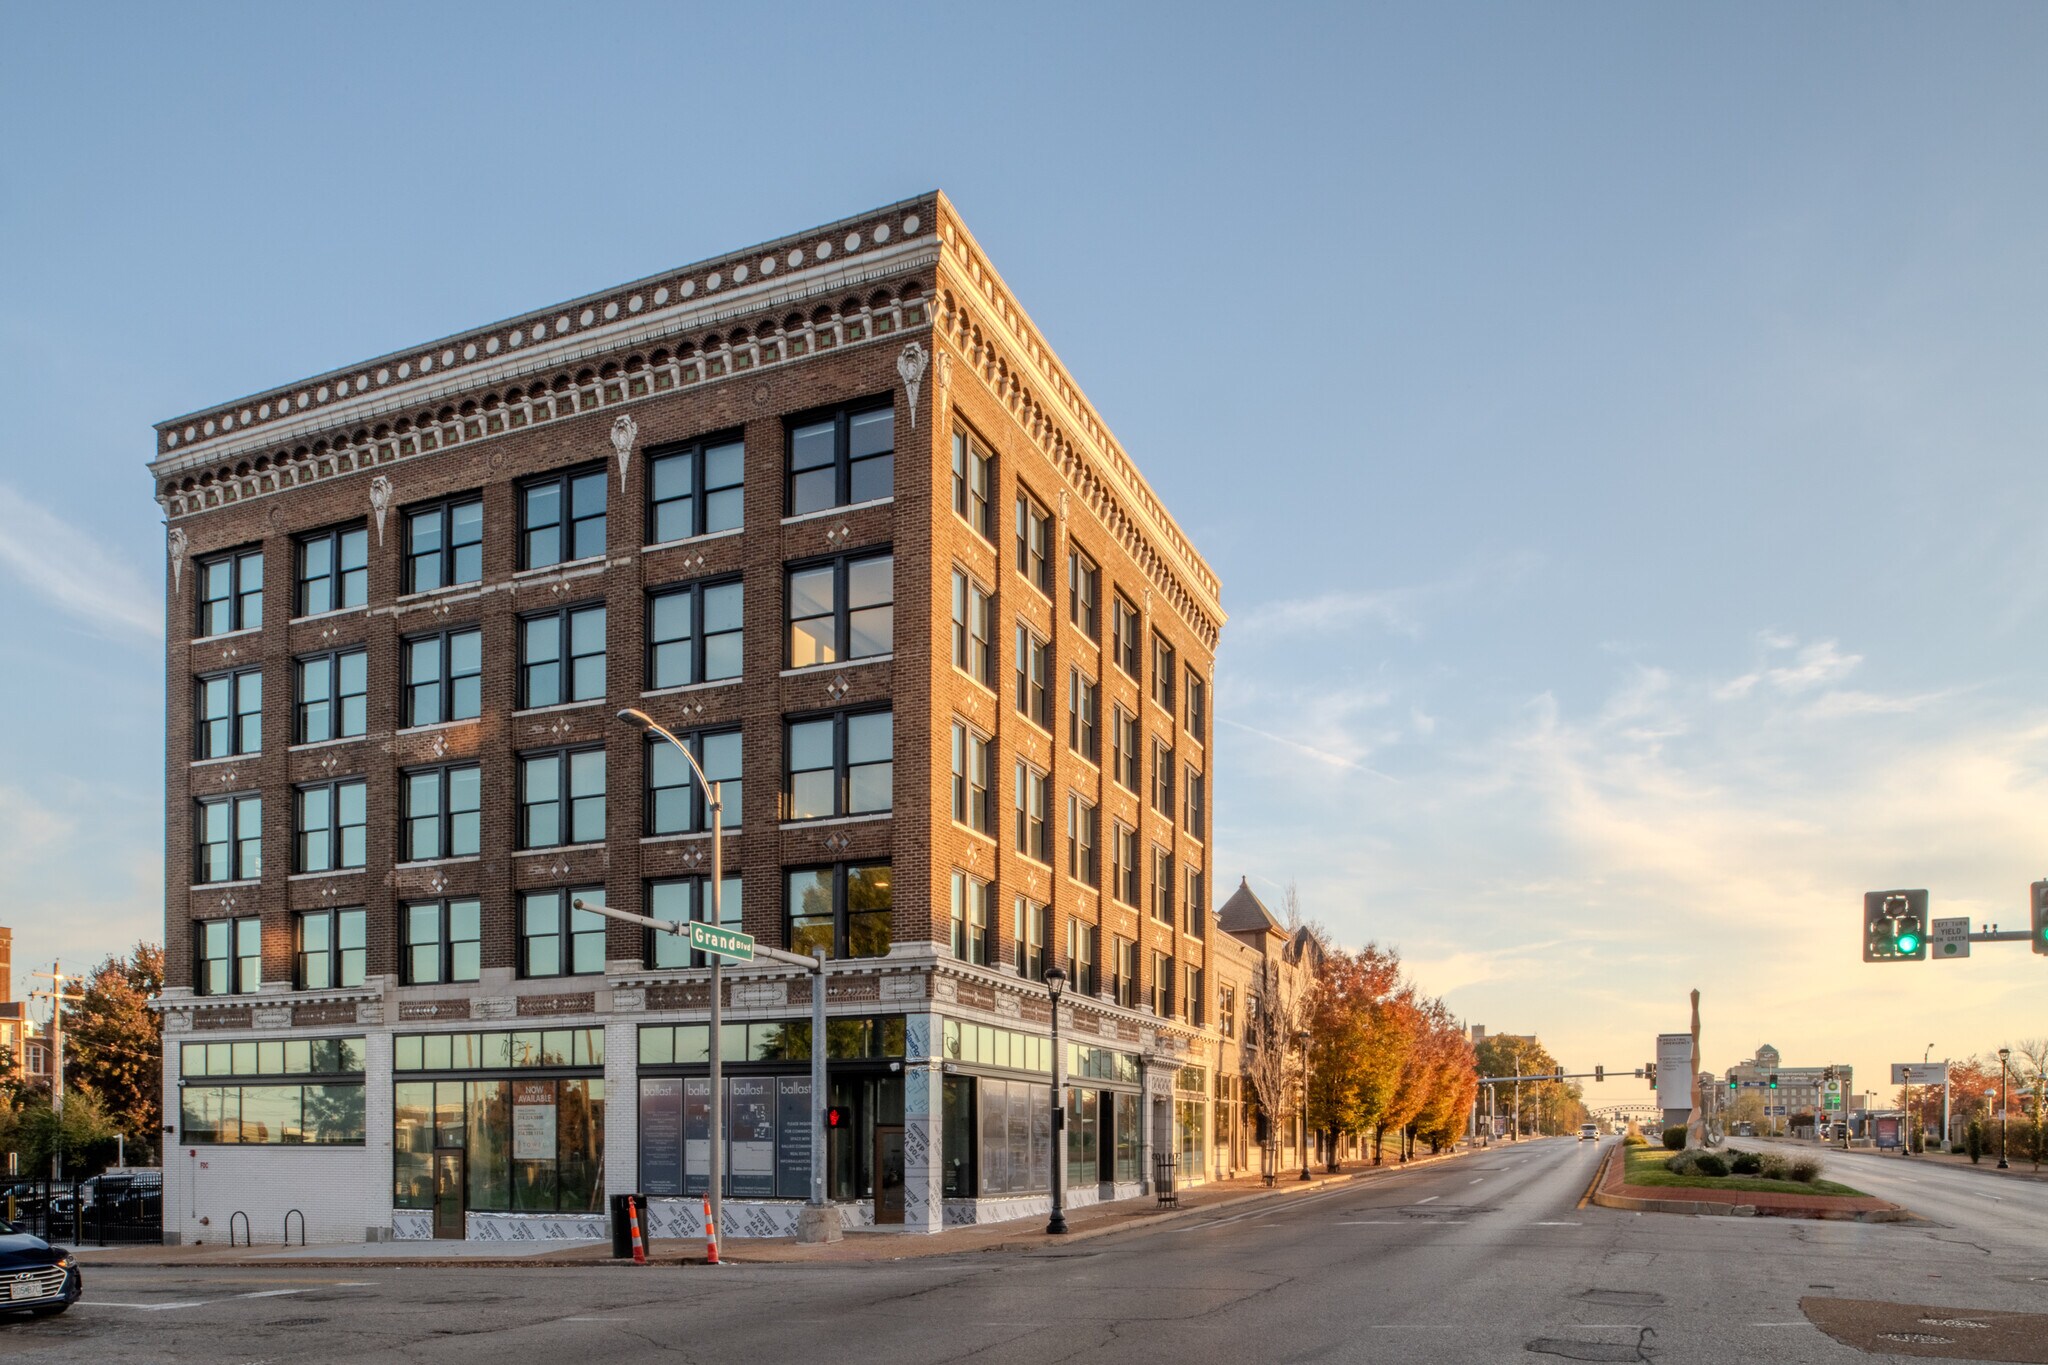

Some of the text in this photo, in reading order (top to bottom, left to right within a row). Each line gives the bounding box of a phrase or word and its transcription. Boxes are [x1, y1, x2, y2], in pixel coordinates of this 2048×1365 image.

[695, 927, 751, 951] Grand Blvd
[525, 1086, 544, 1094] NOW
[644, 1084, 672, 1096] ballast
[688, 1083, 710, 1096] balla
[733, 1082, 764, 1095] ballast
[781, 1081, 812, 1095] ballast
[518, 1094, 552, 1103] AVAILABLE
[905, 1129, 917, 1142] 705
[916, 1141, 925, 1151] VP
[649, 1222, 657, 1231] VP
[677, 1211, 687, 1224] 705
[686, 1223, 695, 1233] VP
[754, 1213, 765, 1227] 705
[764, 1225, 773, 1235] VP
[725, 1224, 734, 1234] VP
